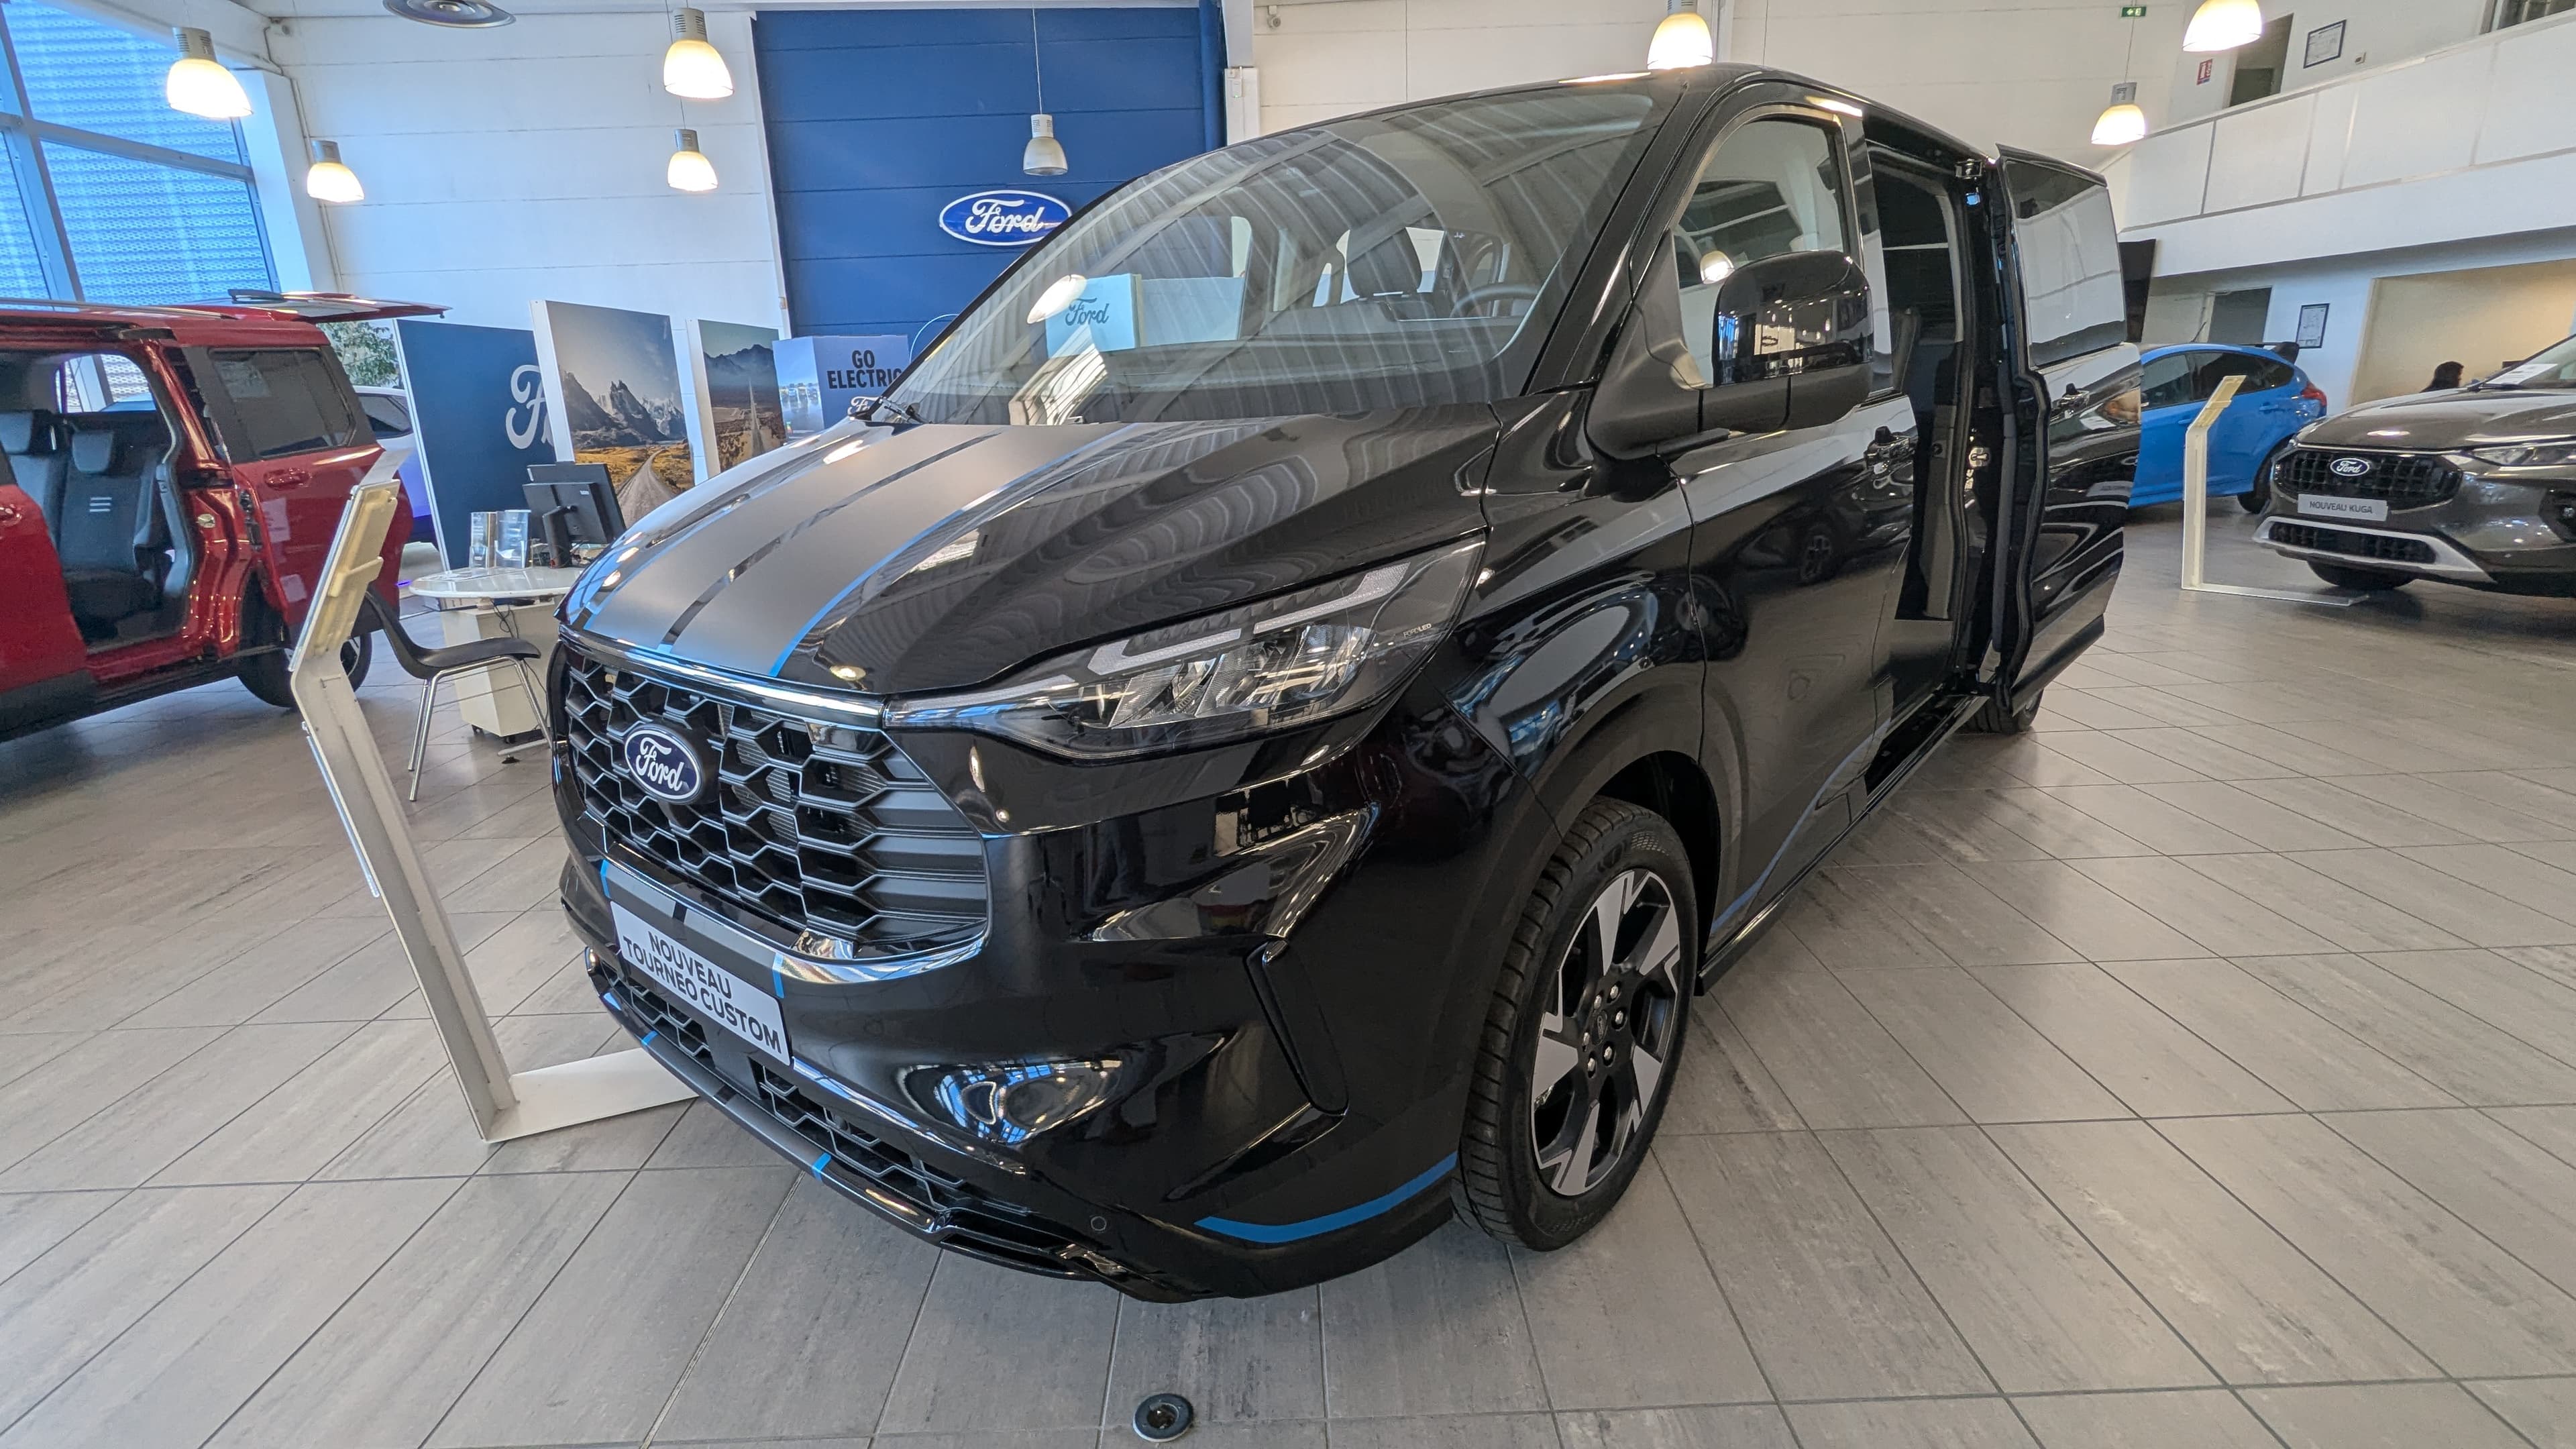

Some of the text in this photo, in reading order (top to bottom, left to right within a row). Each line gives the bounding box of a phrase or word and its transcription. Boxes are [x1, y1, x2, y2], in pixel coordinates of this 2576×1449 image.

[965, 199, 1044, 233] Ford
[1065, 297, 1110, 326] Ford
[851, 350, 875, 369] GO
[2337, 460, 2363, 473] Ford
[2309, 501, 2373, 514] NOUVEAU KUGA
[635, 737, 685, 792] Ford
[648, 930, 733, 1000] NOUVEAU
[623, 936, 782, 1055] TOURNEO CUSTOM
